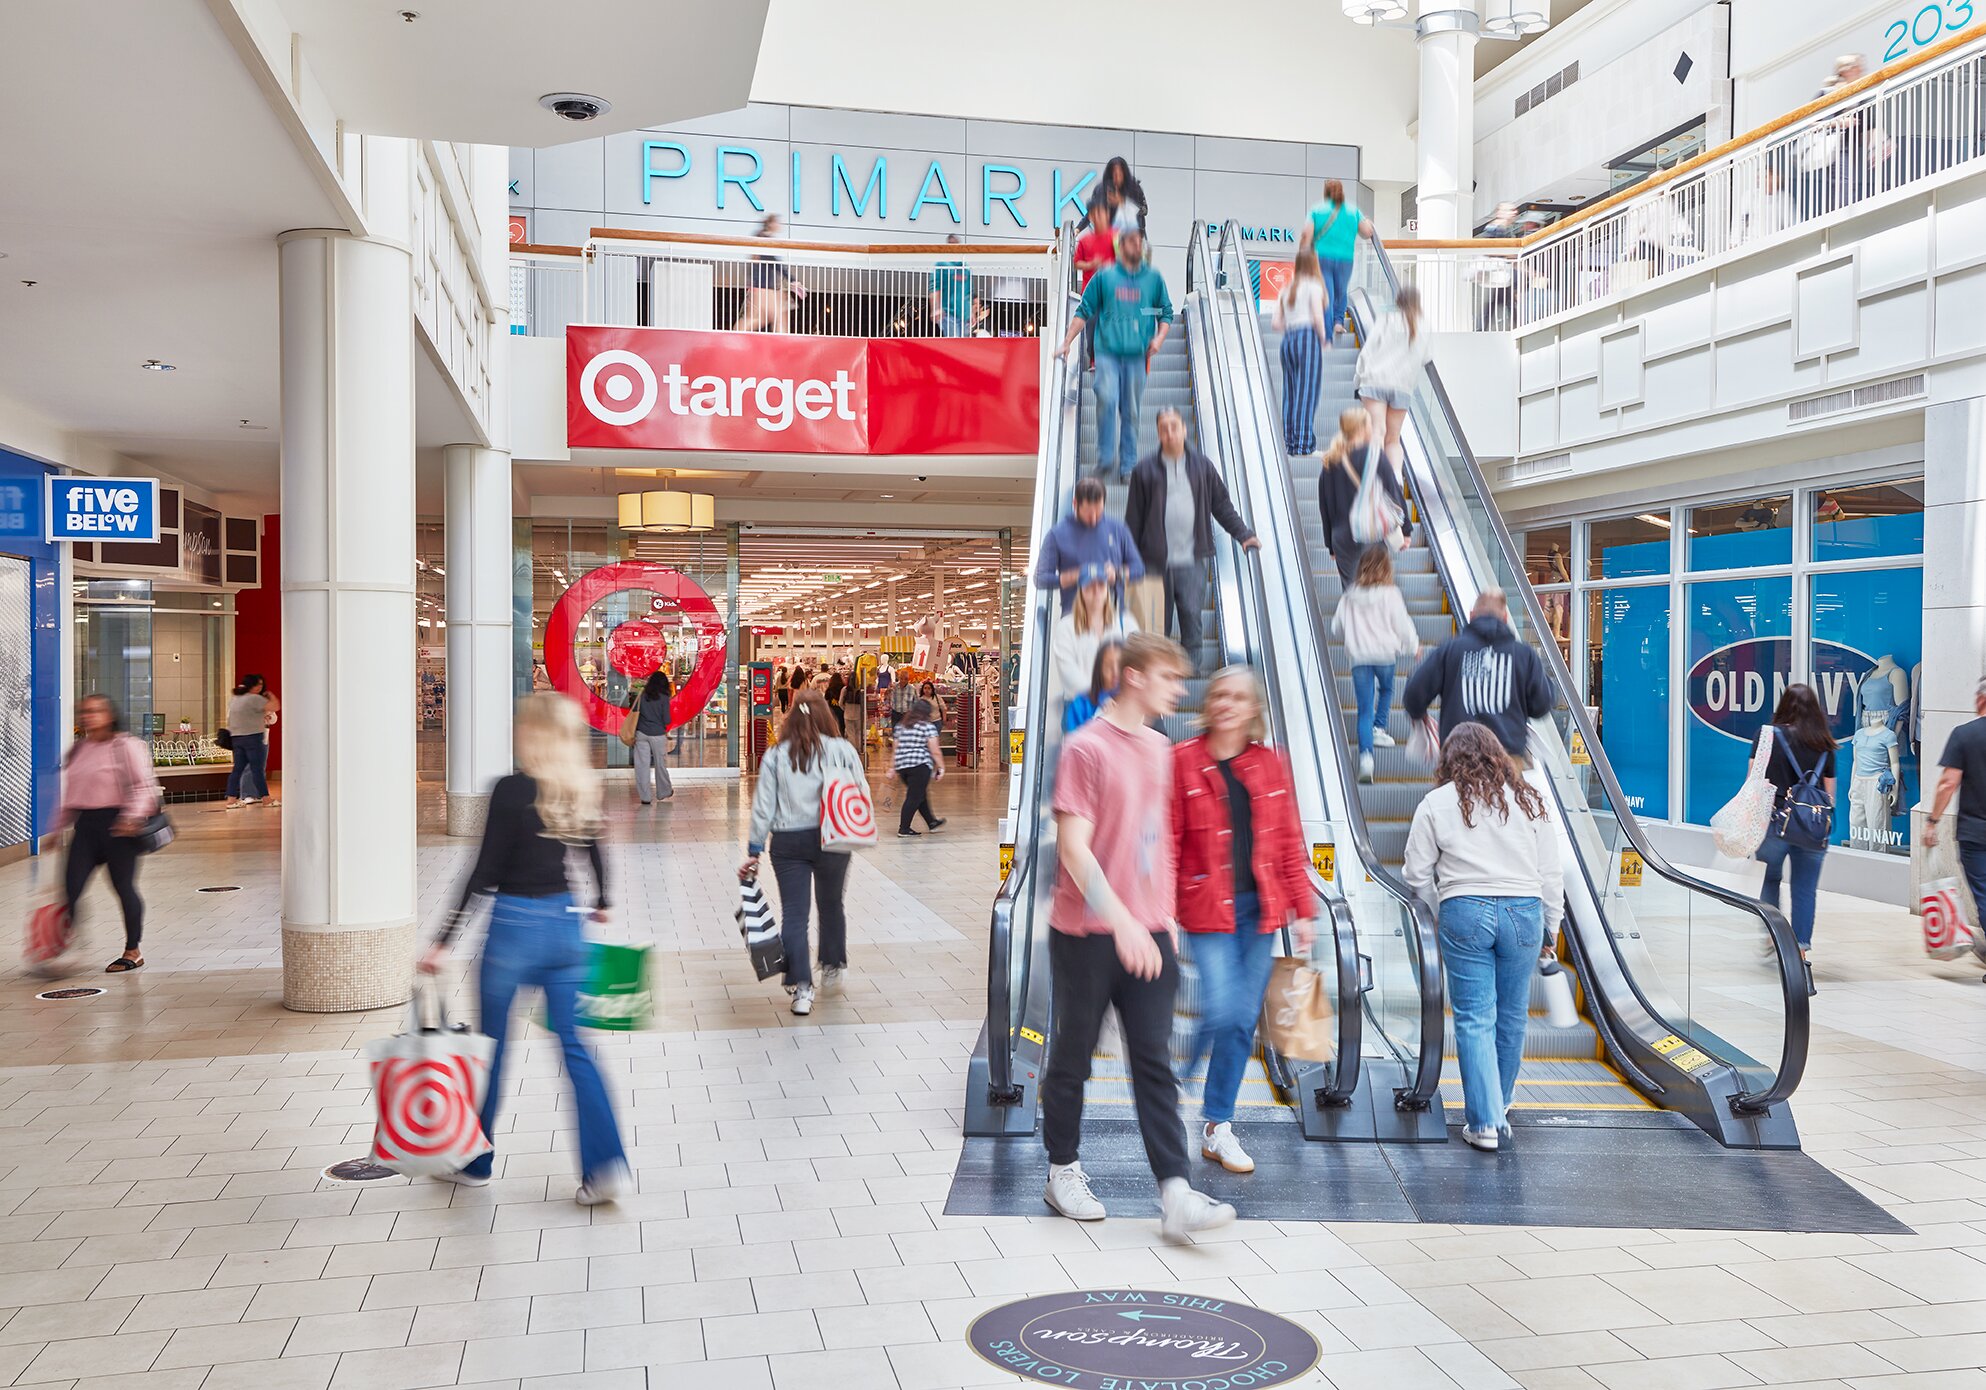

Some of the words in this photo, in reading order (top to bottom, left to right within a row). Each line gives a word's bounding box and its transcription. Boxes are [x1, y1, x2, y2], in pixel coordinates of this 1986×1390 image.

[1883, 0, 1973, 63] 203
[643, 140, 1098, 229] PRIMARK
[1207, 223, 1295, 243] PMARK
[663, 364, 857, 432] target
[66, 487, 139, 513] five
[1706, 670, 1765, 712] OLD
[1850, 826, 1870, 842] OLD
[1873, 829, 1904, 847] NAVY
[1085, 1292, 1148, 1303] WAY
[1163, 1294, 1226, 1313] THIS
[1033, 1328, 1249, 1360] Thompson
[1144, 1331, 1224, 1342] BRIGADEIROS
[990, 1340, 1081, 1384] LOVERS
[1100, 1360, 1288, 1390] CHOCOLATE
